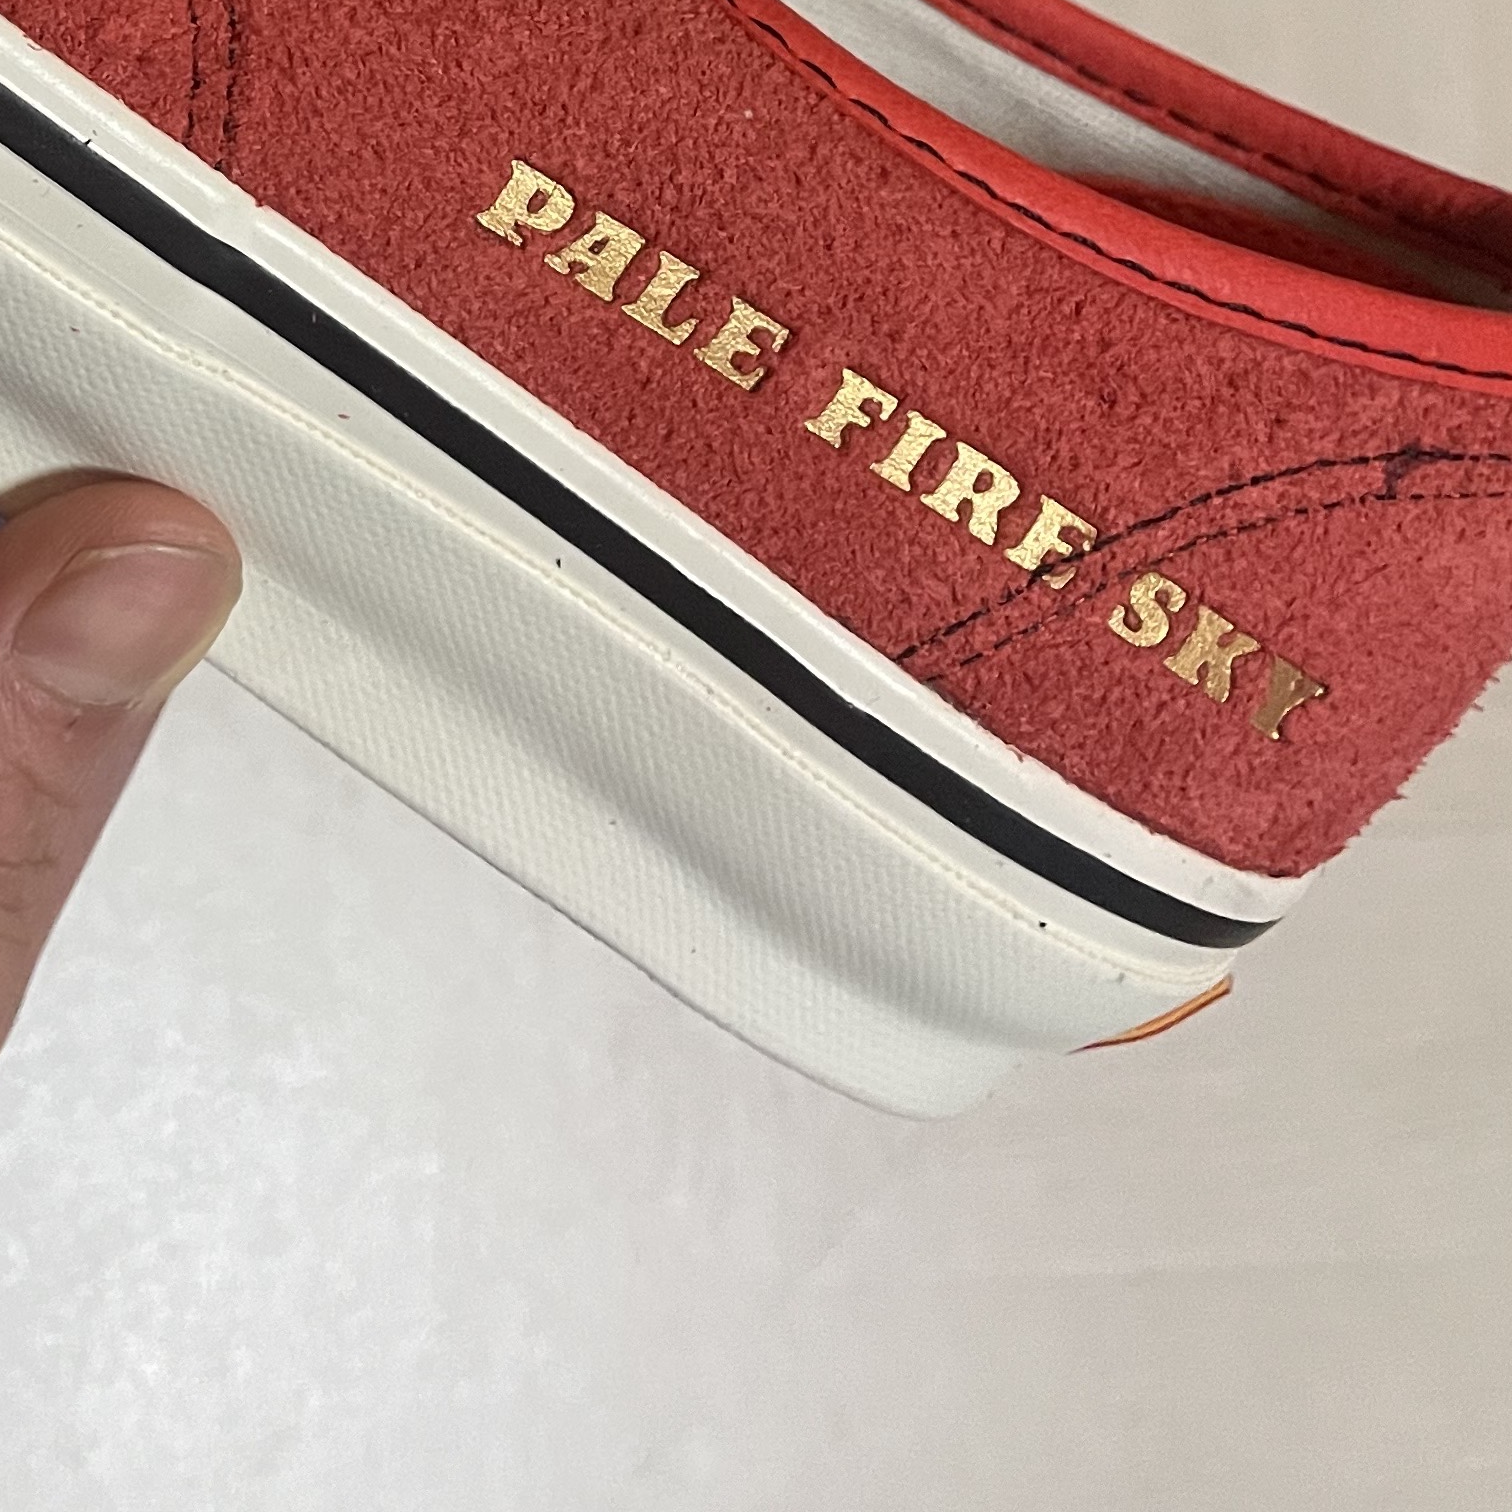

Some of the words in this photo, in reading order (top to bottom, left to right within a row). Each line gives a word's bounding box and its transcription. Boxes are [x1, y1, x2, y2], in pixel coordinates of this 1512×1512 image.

[475, 159, 791, 391] PALE
[803, 367, 1098, 590] FIRE
[1106, 571, 1329, 741] SKY
